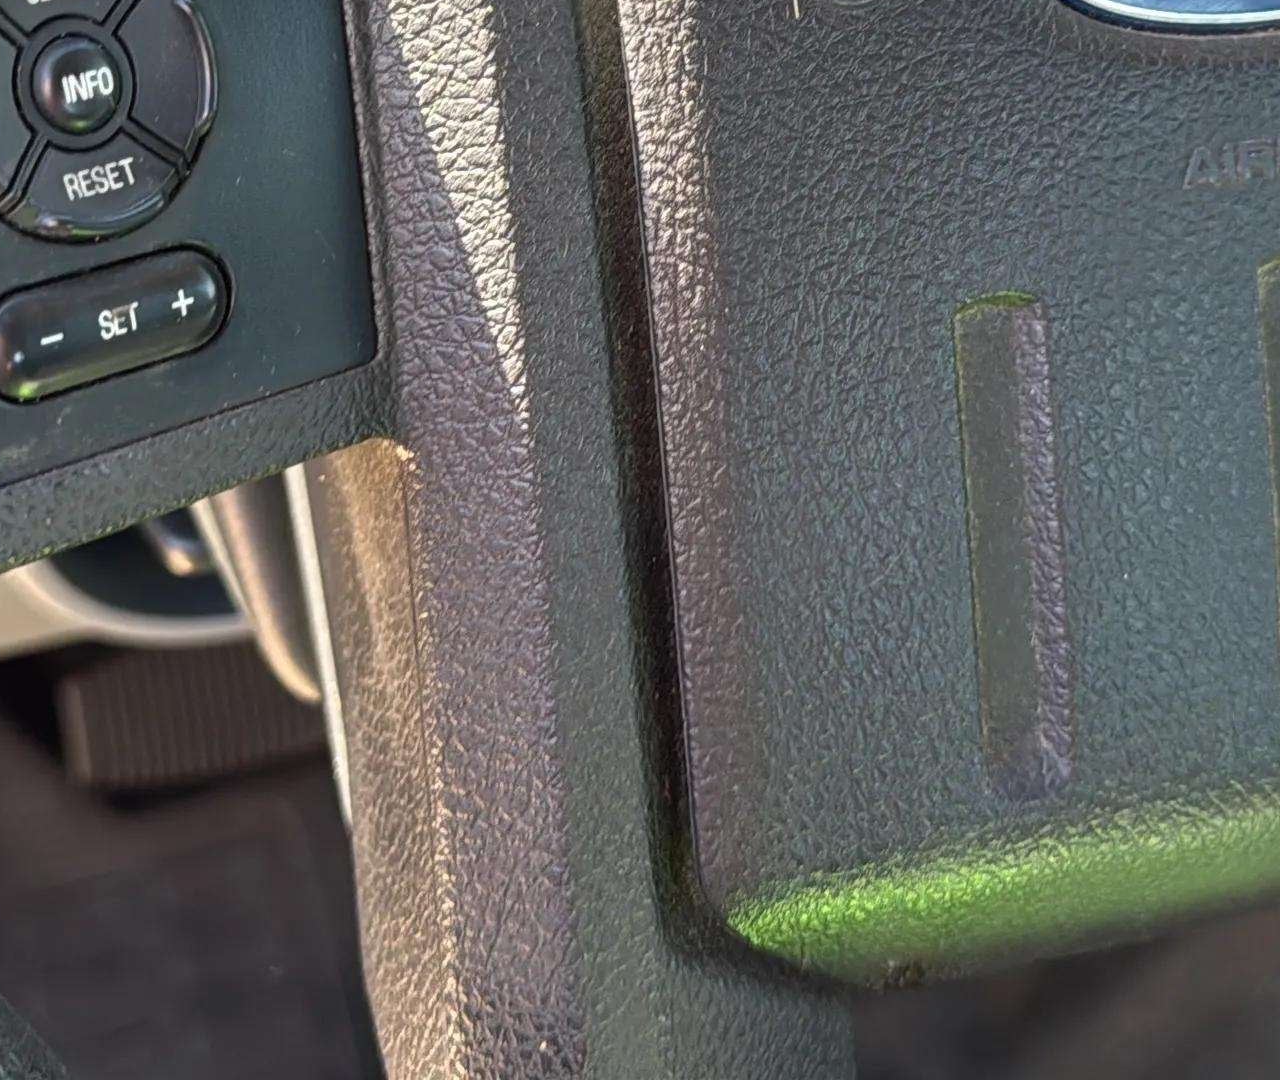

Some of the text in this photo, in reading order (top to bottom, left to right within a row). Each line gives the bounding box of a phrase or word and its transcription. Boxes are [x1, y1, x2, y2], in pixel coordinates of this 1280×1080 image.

[62, 66, 115, 104] INFO
[63, 157, 136, 201] RESET
[98, 301, 140, 341] SET
